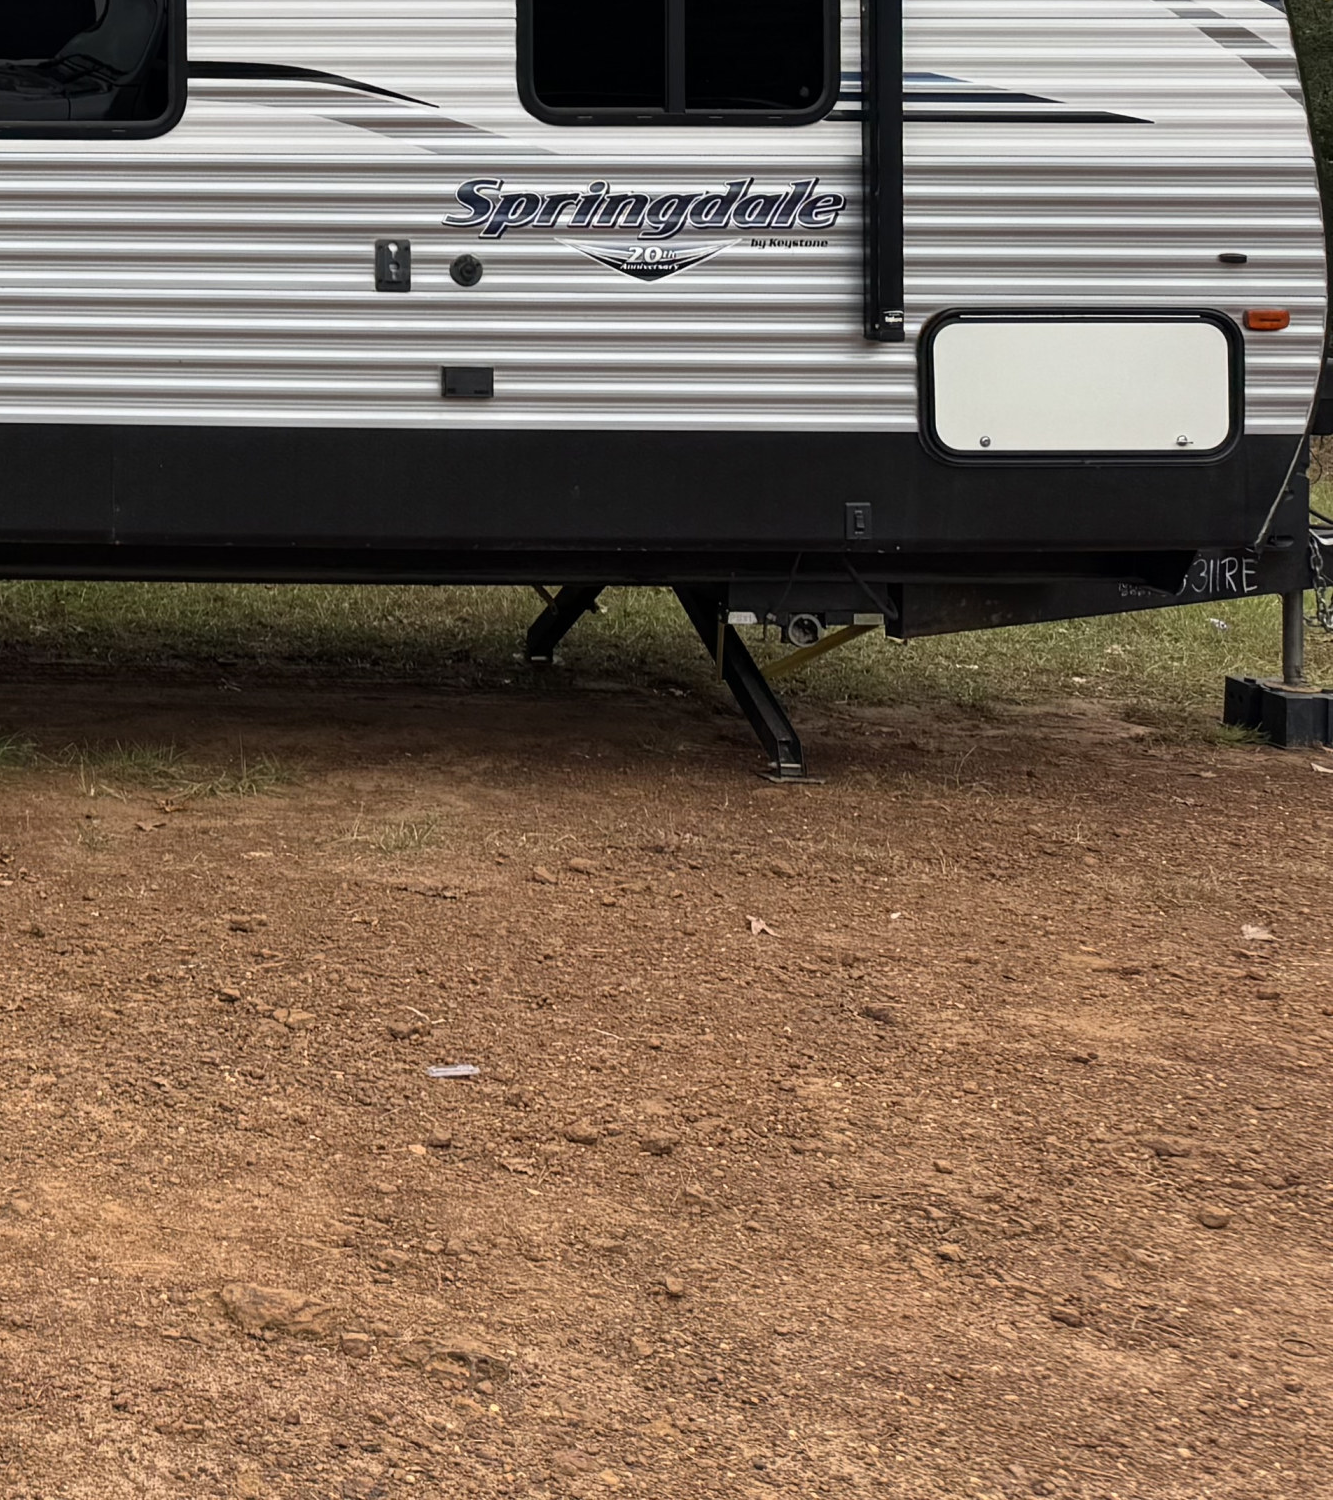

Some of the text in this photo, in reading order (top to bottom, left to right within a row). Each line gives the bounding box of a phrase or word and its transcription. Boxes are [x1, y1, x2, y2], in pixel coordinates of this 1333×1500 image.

[442, 177, 847, 240] Springdale
[750, 238, 829, 250] by Keystone
[626, 246, 678, 263] 20th
[619, 262, 680, 271] Anniversary
